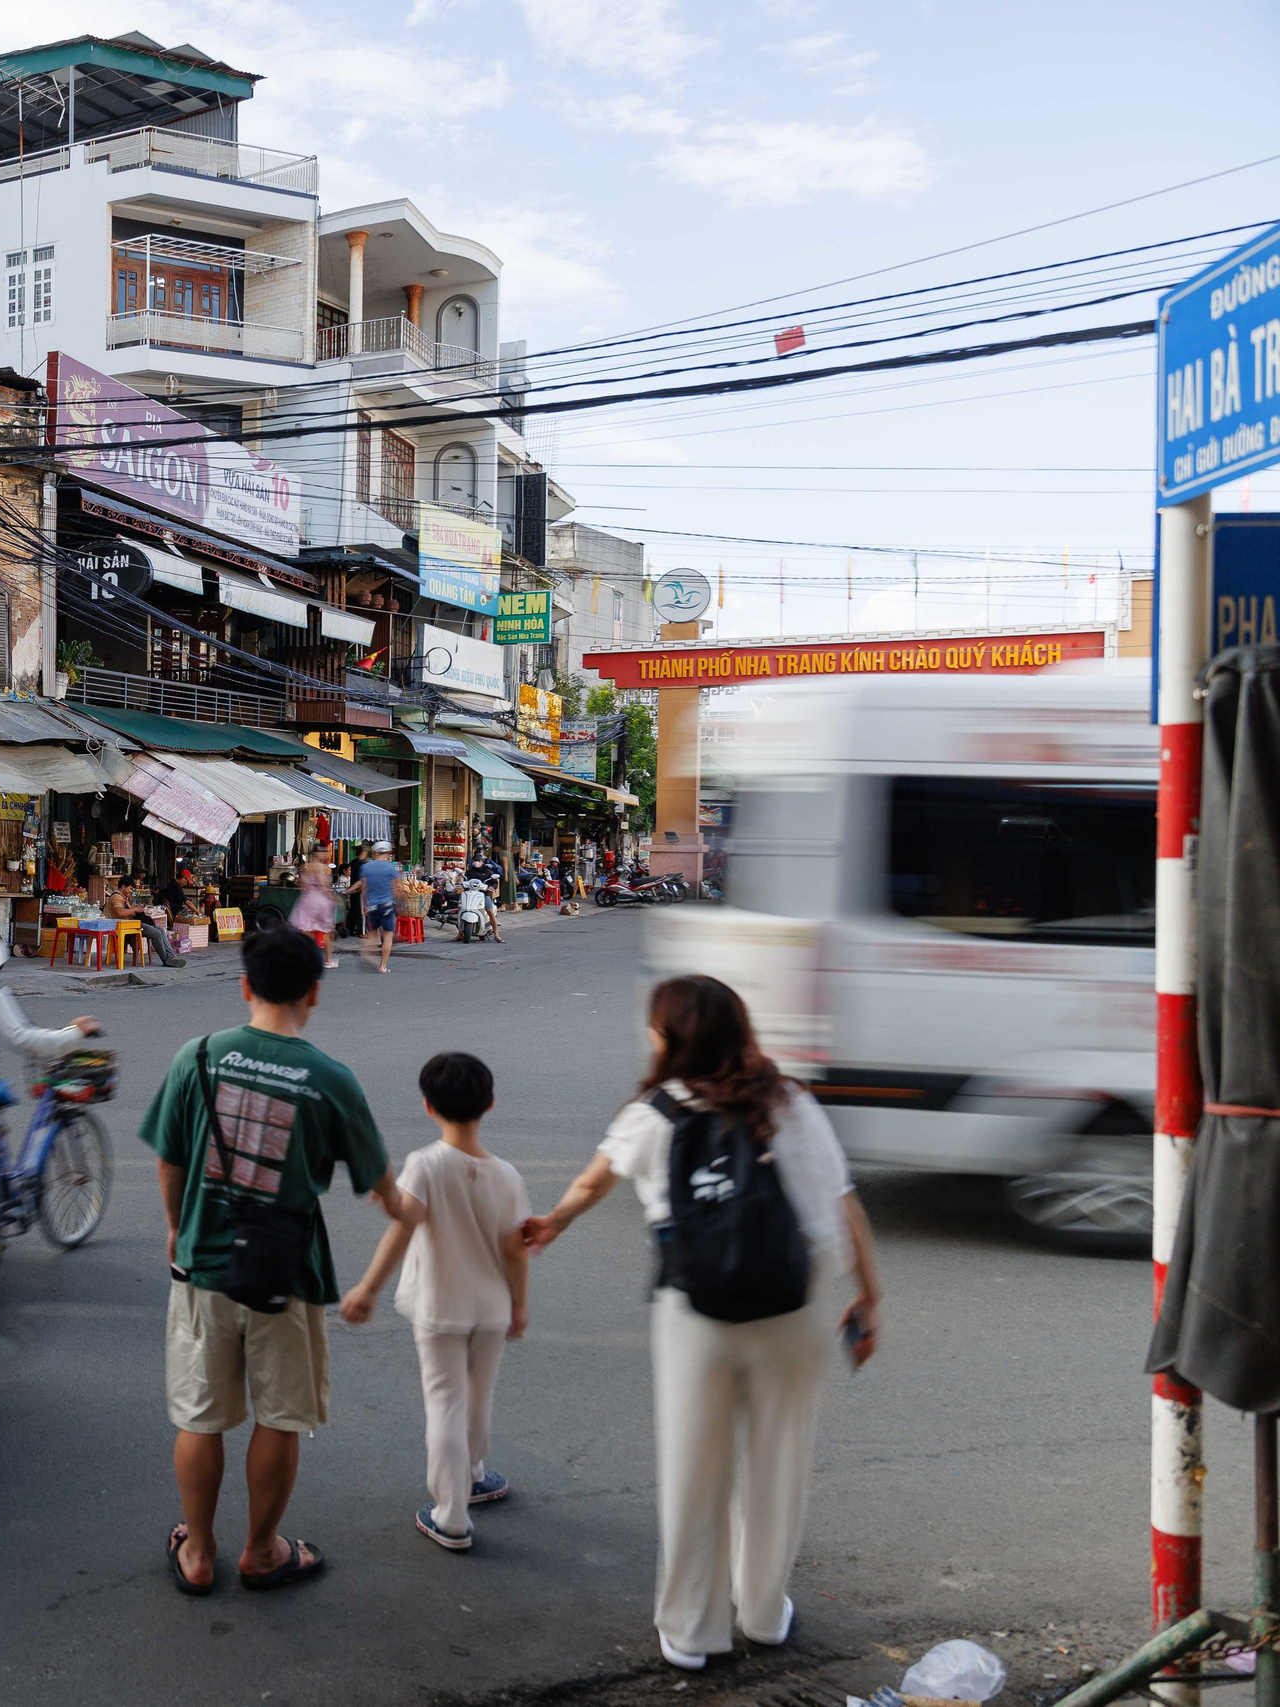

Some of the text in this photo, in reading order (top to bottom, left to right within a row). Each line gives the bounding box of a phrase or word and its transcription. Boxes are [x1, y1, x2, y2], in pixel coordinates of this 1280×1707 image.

[1210, 254, 1280, 321] ĐƯỜNG
[1167, 358, 1204, 443] HAI
[1210, 323, 1242, 423] BÀ
[145, 410, 163, 434] BIA
[1174, 422, 1265, 483] CHỈ GIỚI ĐƯỜNG
[272, 472, 290, 511] 10
[78, 550, 129, 570] HẢI SẢN
[91, 572, 118, 600] 10
[429, 577, 476, 606] QUẢNG TÂM
[462, 572, 479, 586] TRANG
[498, 593, 547, 615] NEM
[496, 616, 544, 631] NINH HÒA
[639, 640, 1062, 679] THÀNH PHỐ NHA TRANG KÍNH CHÀO QUÝ KHÁCH
[218, 1067, 256, 1082] Balance
[256, 1075, 298, 1094] Running
